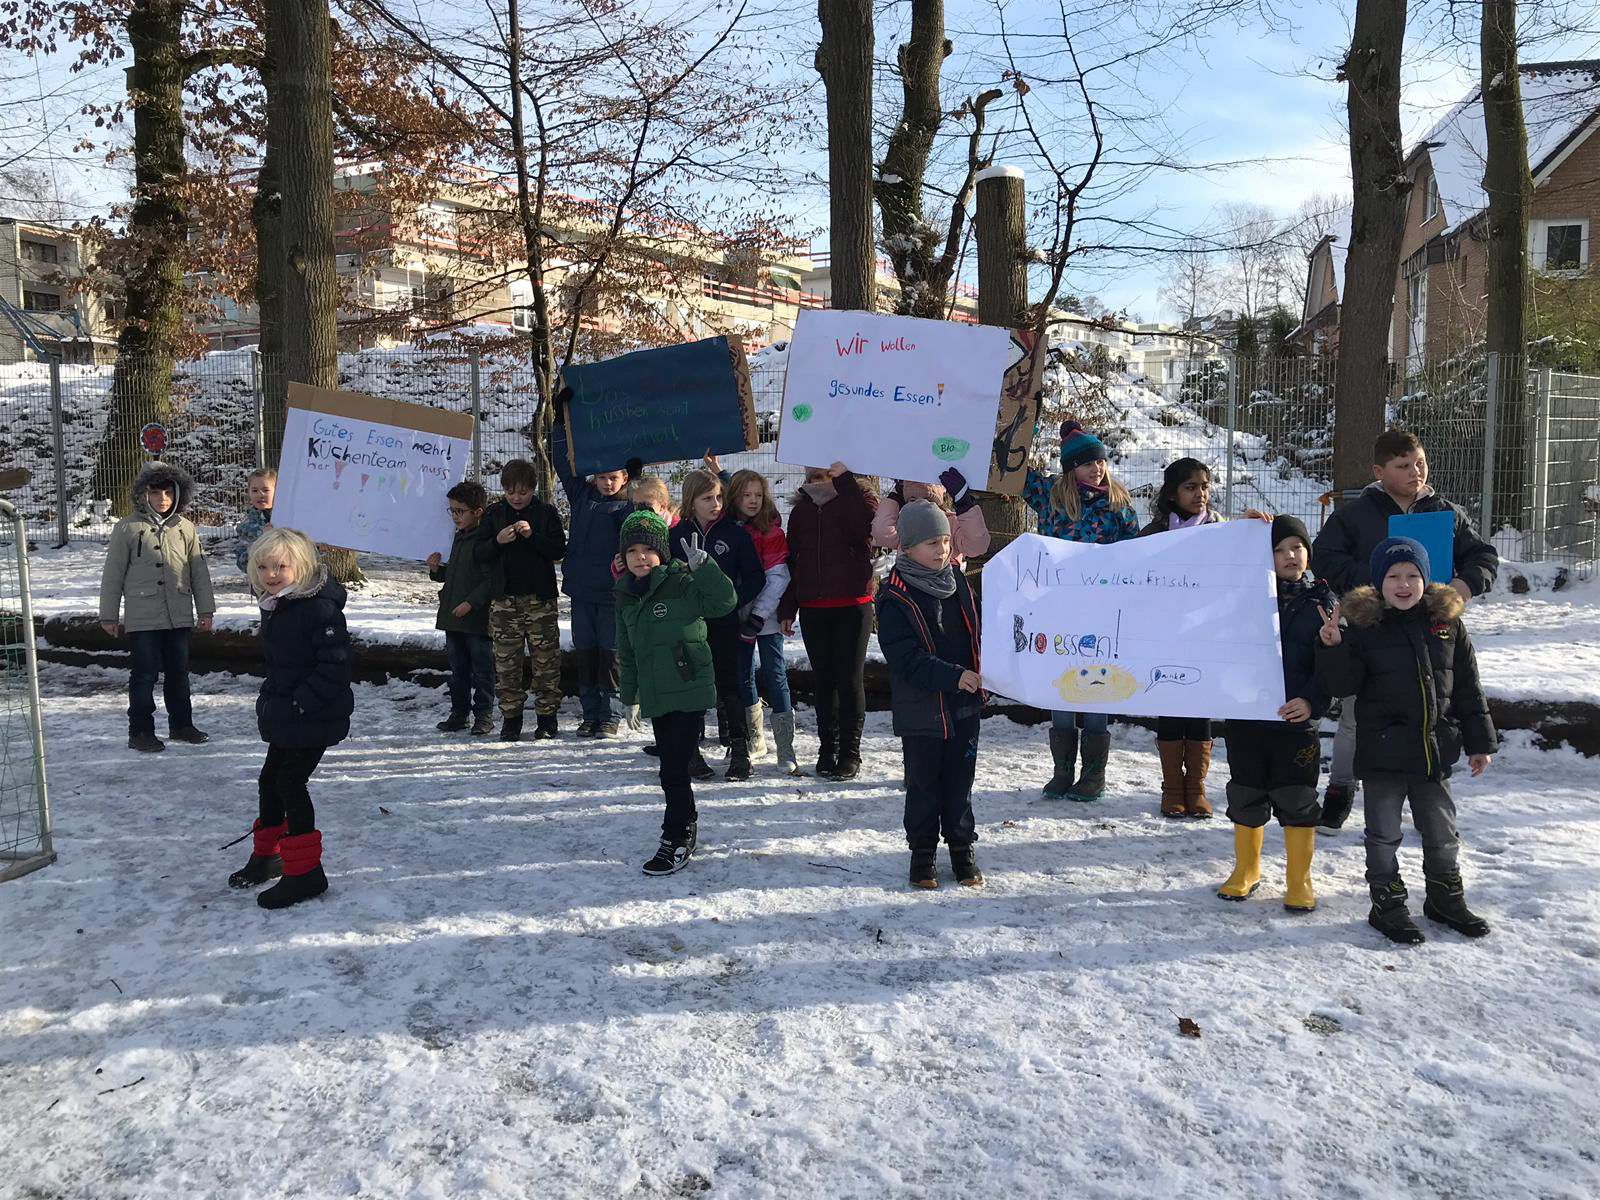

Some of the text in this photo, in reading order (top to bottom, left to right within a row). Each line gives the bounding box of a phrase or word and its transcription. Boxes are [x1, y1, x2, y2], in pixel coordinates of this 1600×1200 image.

[835, 332, 870, 357] Wir
[828, 379, 945, 407] gesundes Essen!
[308, 437, 407, 469] Küchenteam
[313, 418, 354, 442] Gutes
[412, 440, 452, 461] mehr!
[1016, 551, 1065, 592] Wir
[1154, 668, 1186, 682] Danke
